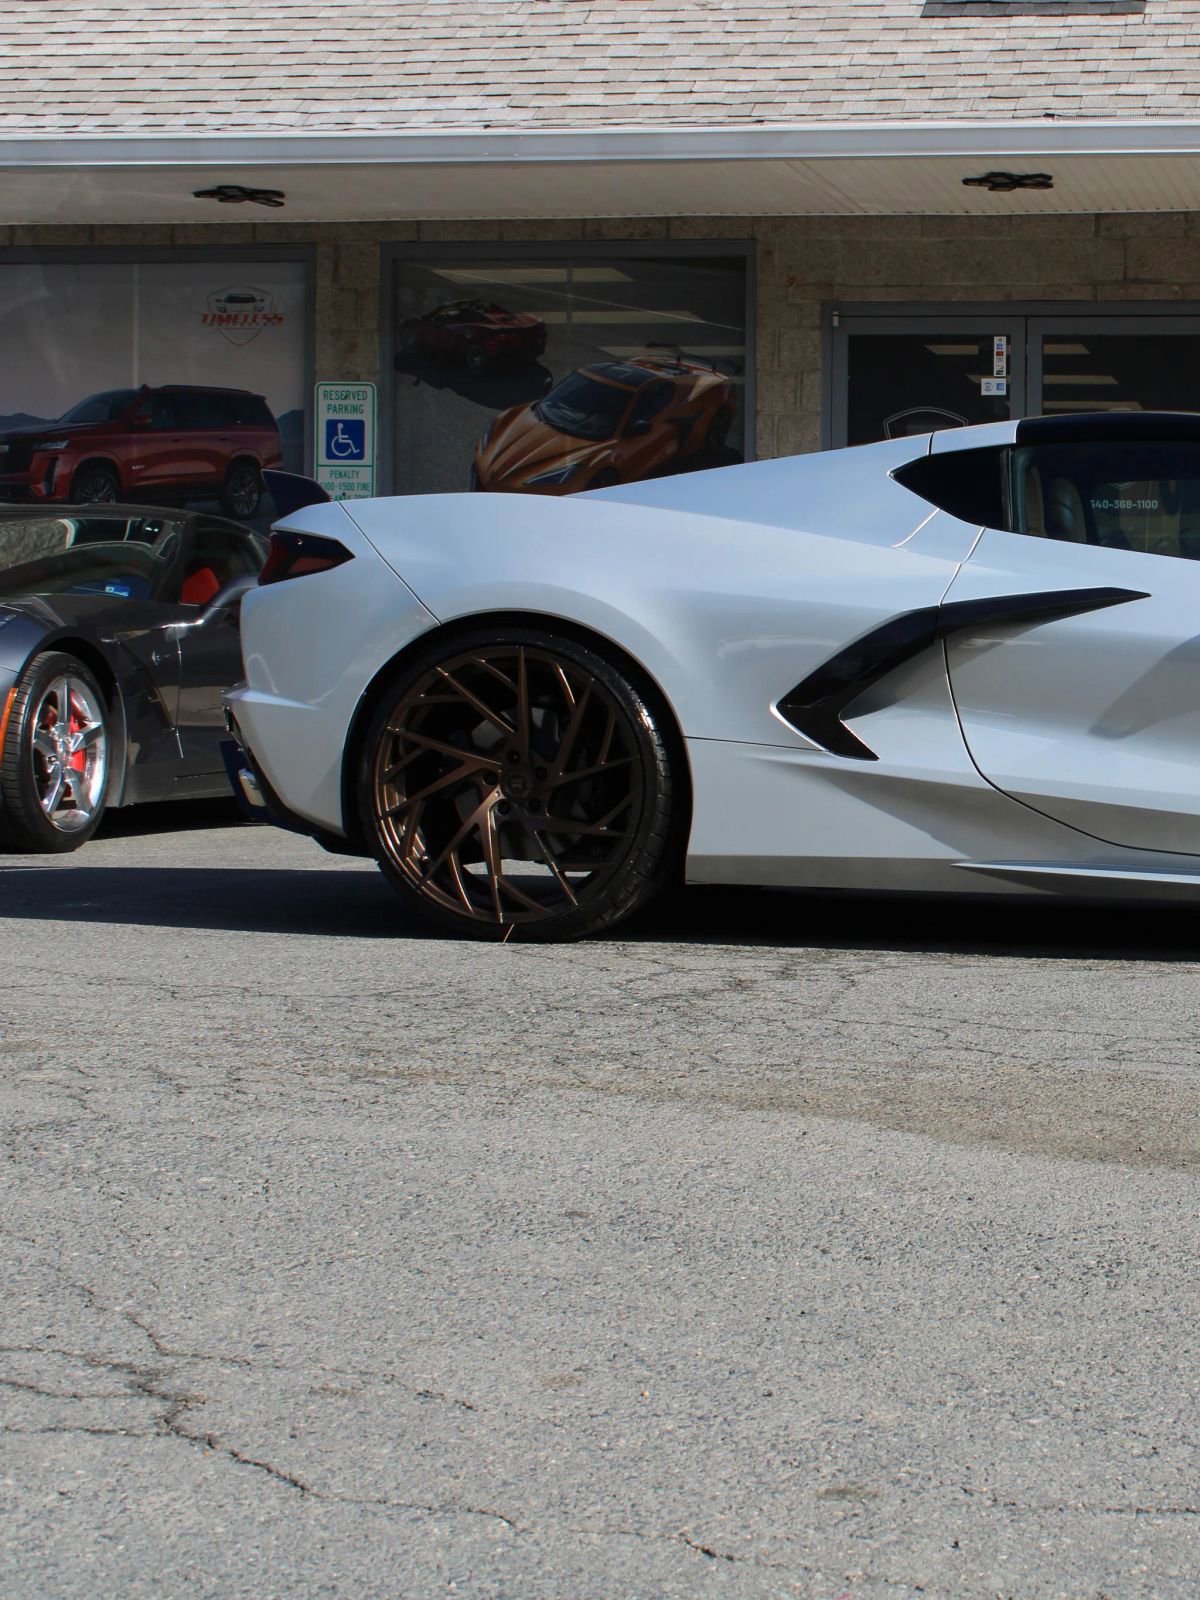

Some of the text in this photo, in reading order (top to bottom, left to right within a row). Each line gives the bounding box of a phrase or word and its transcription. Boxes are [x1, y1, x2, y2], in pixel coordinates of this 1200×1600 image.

[200, 313, 285, 324] TIMELESS
[323, 390, 368, 400] RESERVED
[327, 403, 364, 414] PARKING
[329, 470, 360, 479] PENALTY
[357, 482, 371, 491] FINE
